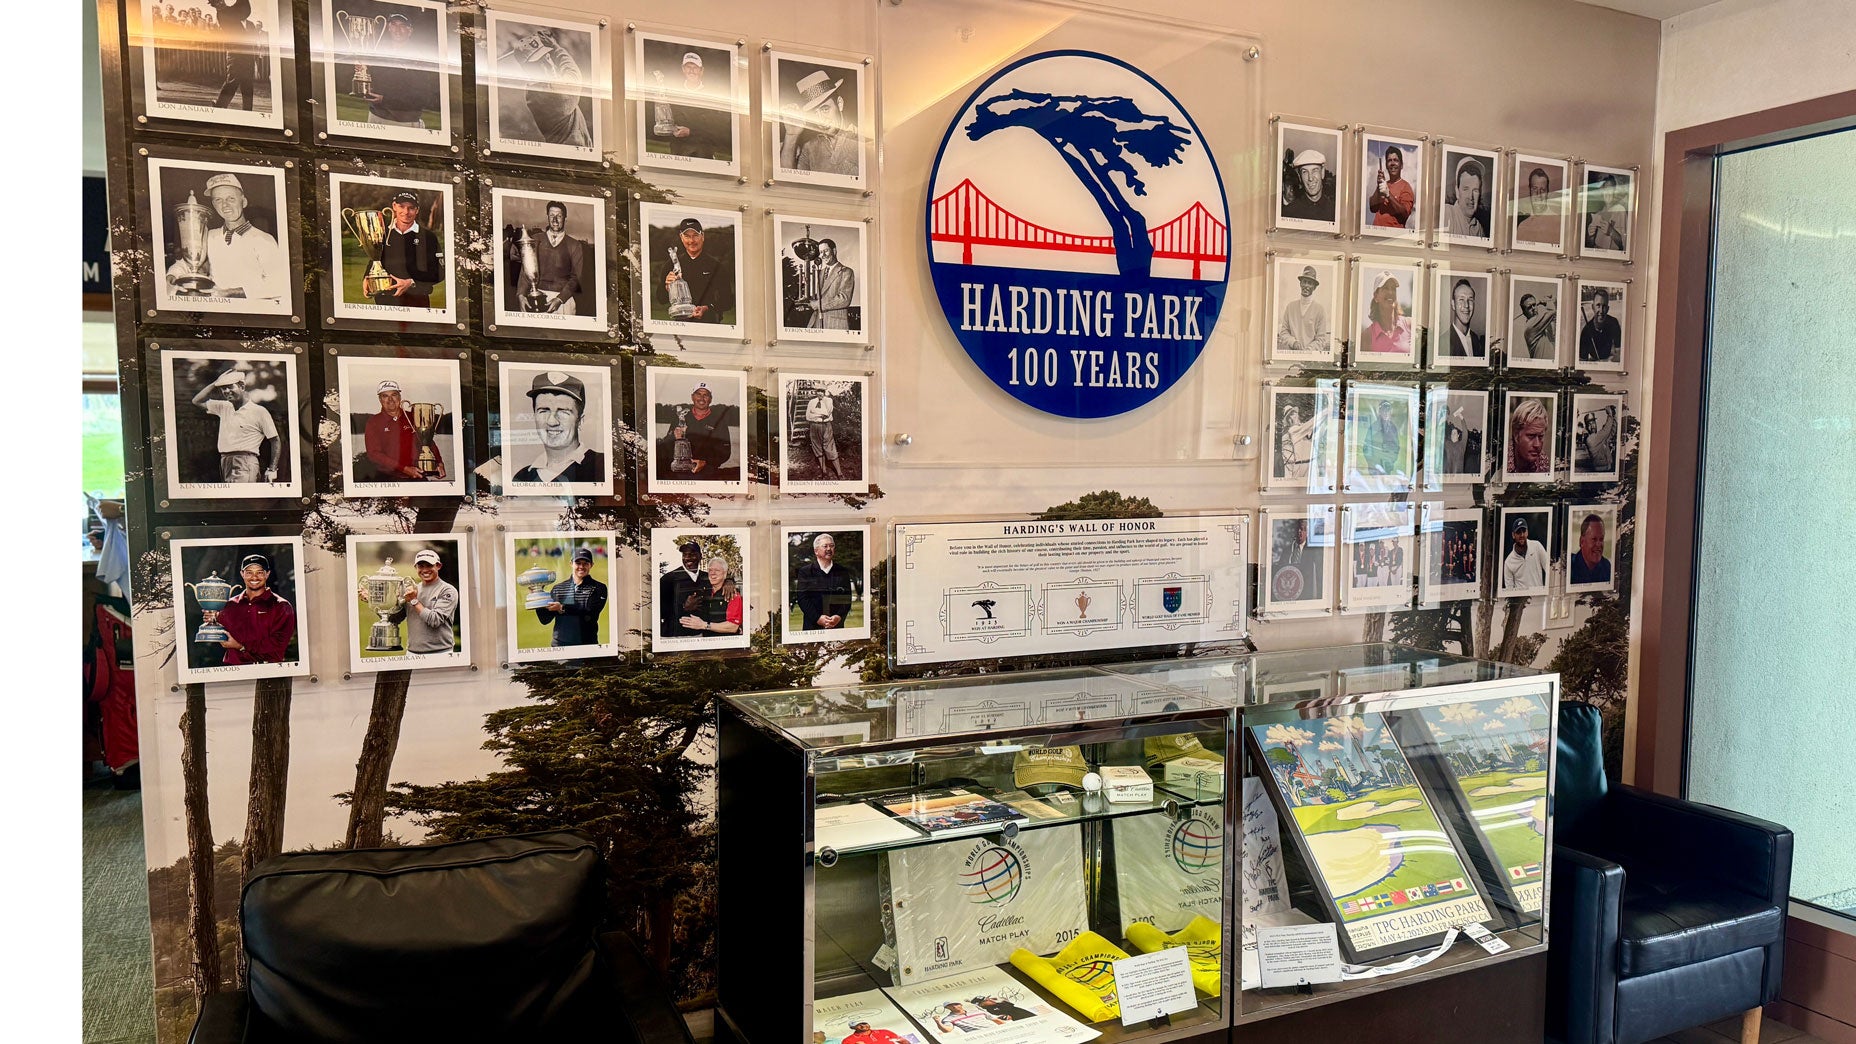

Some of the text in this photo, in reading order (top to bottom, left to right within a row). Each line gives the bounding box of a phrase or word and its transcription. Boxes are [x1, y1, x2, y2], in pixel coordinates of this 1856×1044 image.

[179, 104, 214, 114] JANUARY
[960, 282, 1203, 340] HARDING PARK
[1007, 348, 1160, 389] 100 YEARS
[1004, 522, 1156, 534] HARDING'S WALL OF HONOR
[965, 844, 981, 867] WORLD
[978, 914, 1024, 933] Cadillac
[1373, 900, 1485, 934] TPC HARDING PARK
[980, 930, 1030, 945] MATCH PLAY
[1056, 928, 1079, 943] 2015
[1380, 933, 1397, 944] MAY
[1424, 926, 1438, 934] SAN
[924, 959, 963, 972] HARDING PARK
